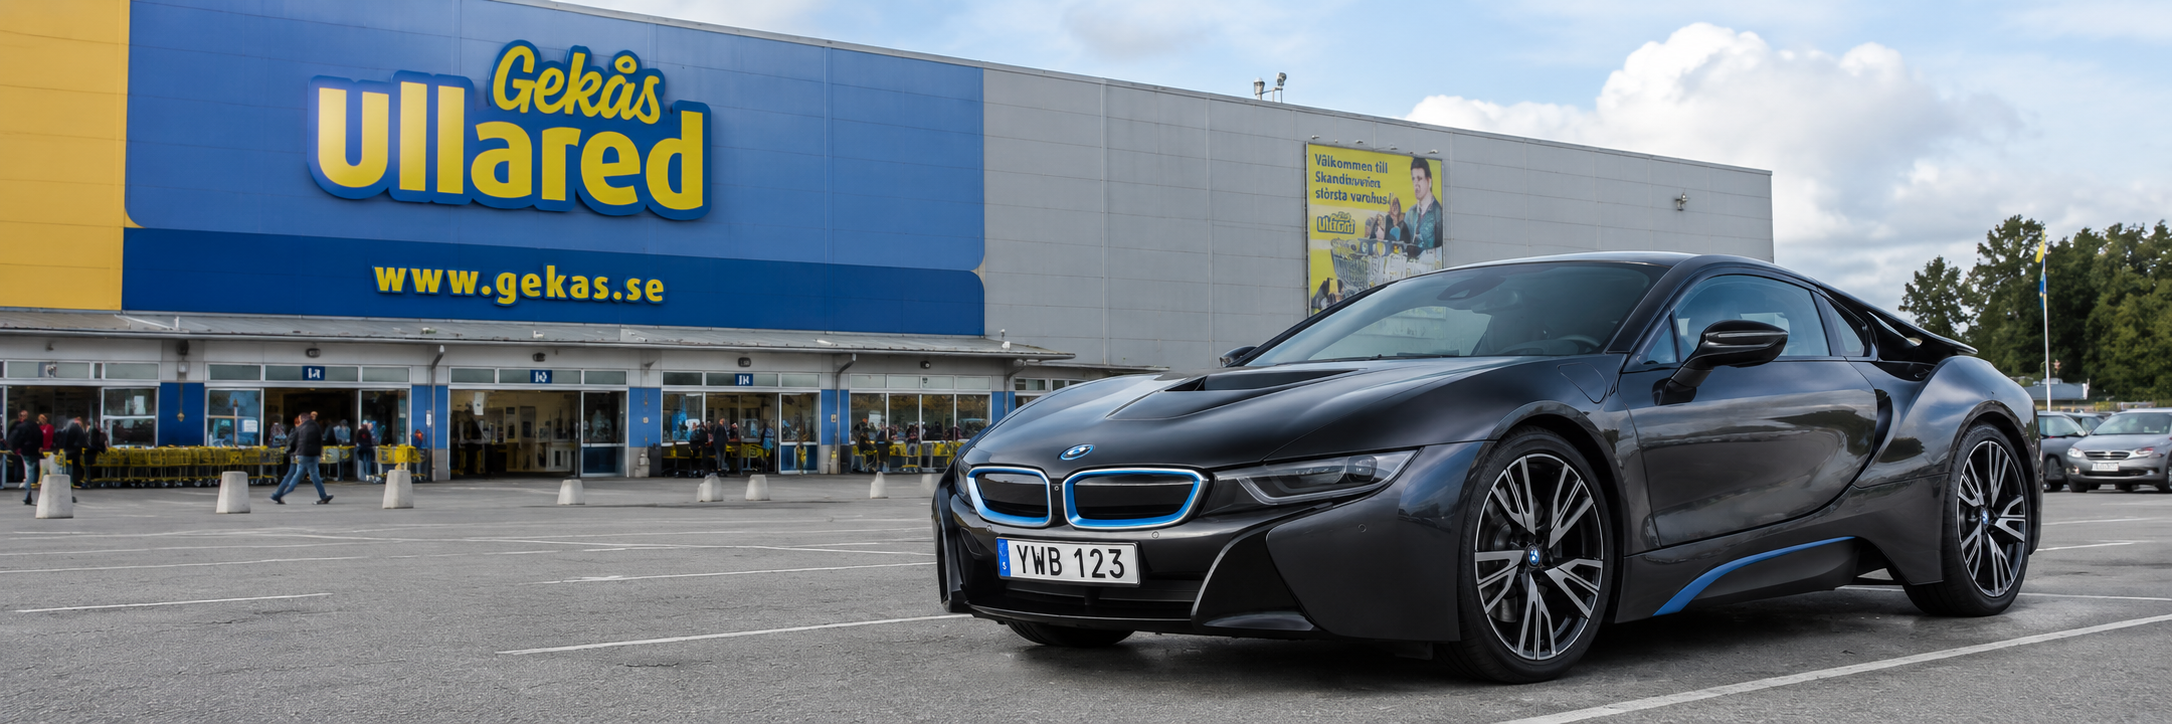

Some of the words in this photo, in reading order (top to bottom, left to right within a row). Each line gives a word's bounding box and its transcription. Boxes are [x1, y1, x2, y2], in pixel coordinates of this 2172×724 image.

[493, 44, 662, 125] Gekås
[318, 81, 704, 211] ullared
[1375, 161, 1388, 174] till
[373, 264, 665, 306] www.gekas.se
[1016, 543, 1063, 576] YWB
[1073, 548, 1125, 579] 123
